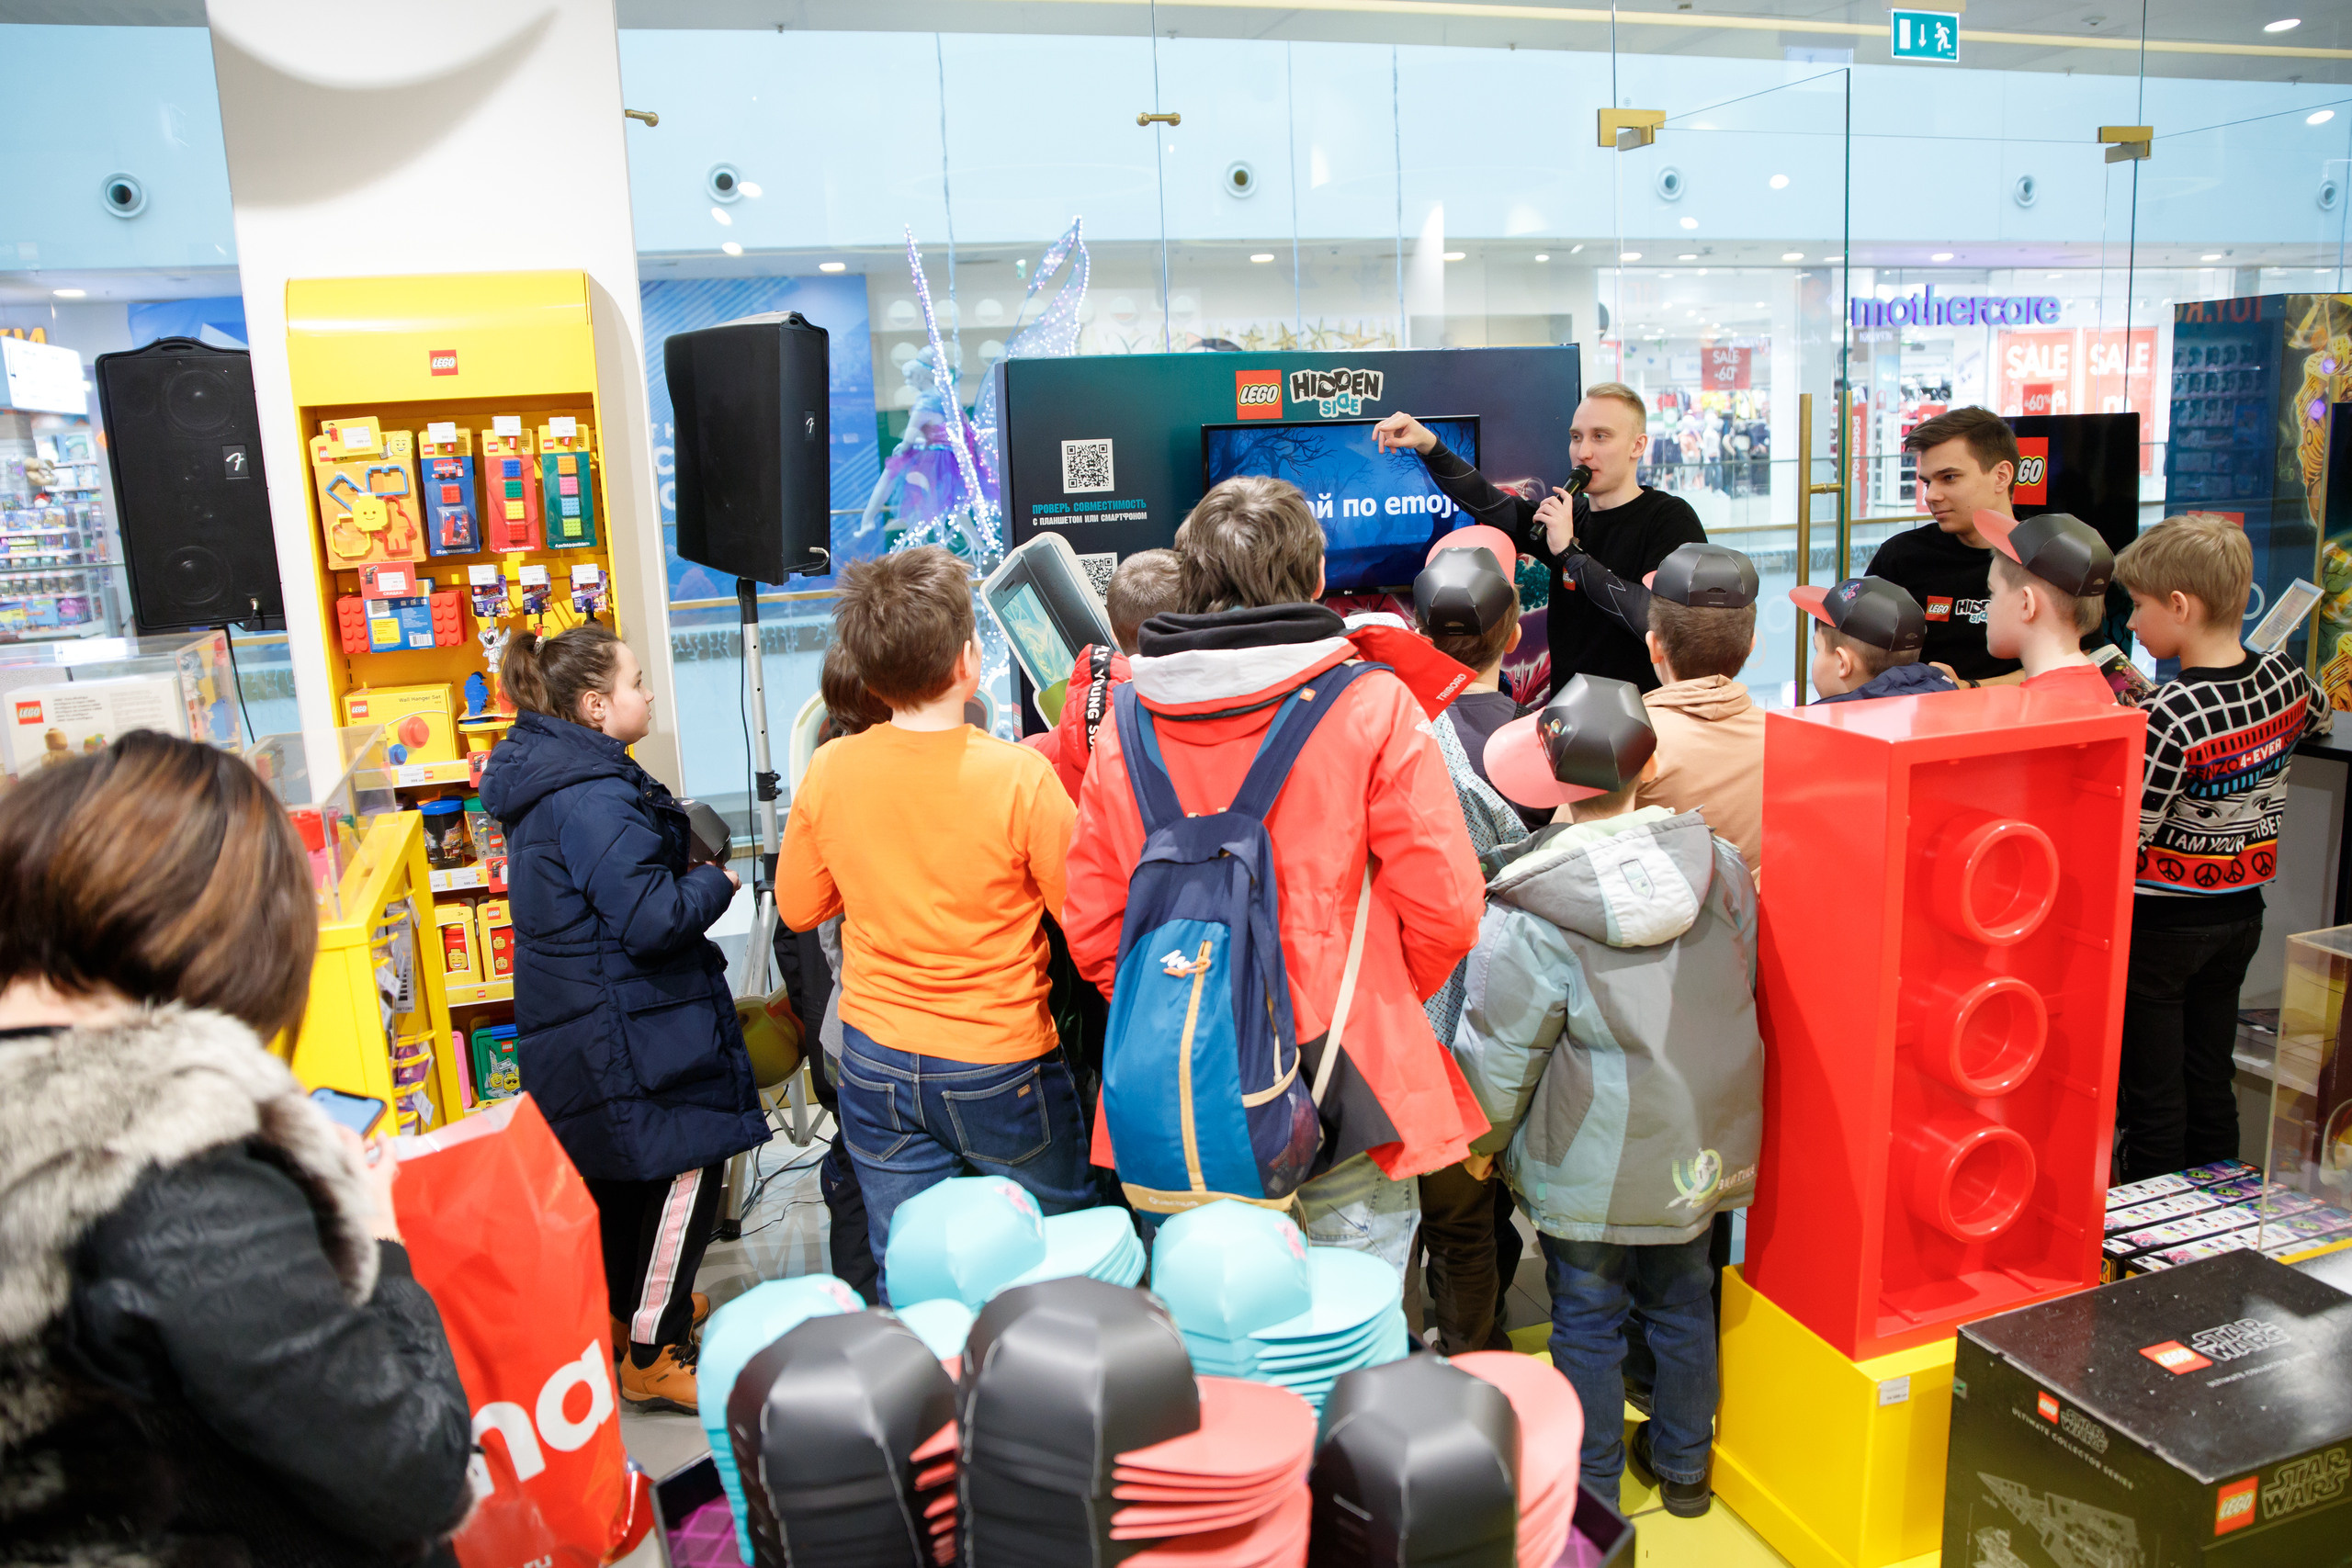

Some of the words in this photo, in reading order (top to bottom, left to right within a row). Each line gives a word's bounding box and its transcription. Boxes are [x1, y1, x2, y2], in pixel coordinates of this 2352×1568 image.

[1851, 284, 2061, 326] mothercare
[432, 356, 457, 369] LEGO
[1713, 350, 1739, 365] SALE
[2006, 344, 2069, 378] SALE
[2089, 343, 2149, 375] SALE
[1239, 384, 1280, 405] LEGO
[1291, 369, 1382, 401] HIDDEN
[1321, 392, 1360, 415] SIDE
[1033, 503, 1070, 514] ПРОВЕРЬ
[1073, 499, 1147, 513] СОВМЕСТИМОСТЬ
[1343, 497, 1377, 517] по
[1039, 515, 1082, 525] ПЛАНШЕТОМ
[1084, 514, 1099, 523] ИЛИ
[1101, 512, 1148, 522] СМАРТФОНОМ
[1928, 604, 1950, 615] LEGO
[1088, 669, 1105, 719] YOUNG
[1436, 673, 1467, 702] TRIBORD
[18, 707, 41, 718] LEGO
[351, 705, 367, 714] LEGO
[2241, 738, 2281, 768] 4-EVER
[2165, 829, 2175, 844] I
[2175, 834, 2206, 852] AM
[2208, 834, 2245, 852] YOUR
[2263, 1448, 2351, 1494] STAR
[2262, 1468, 2349, 1519] WARS
